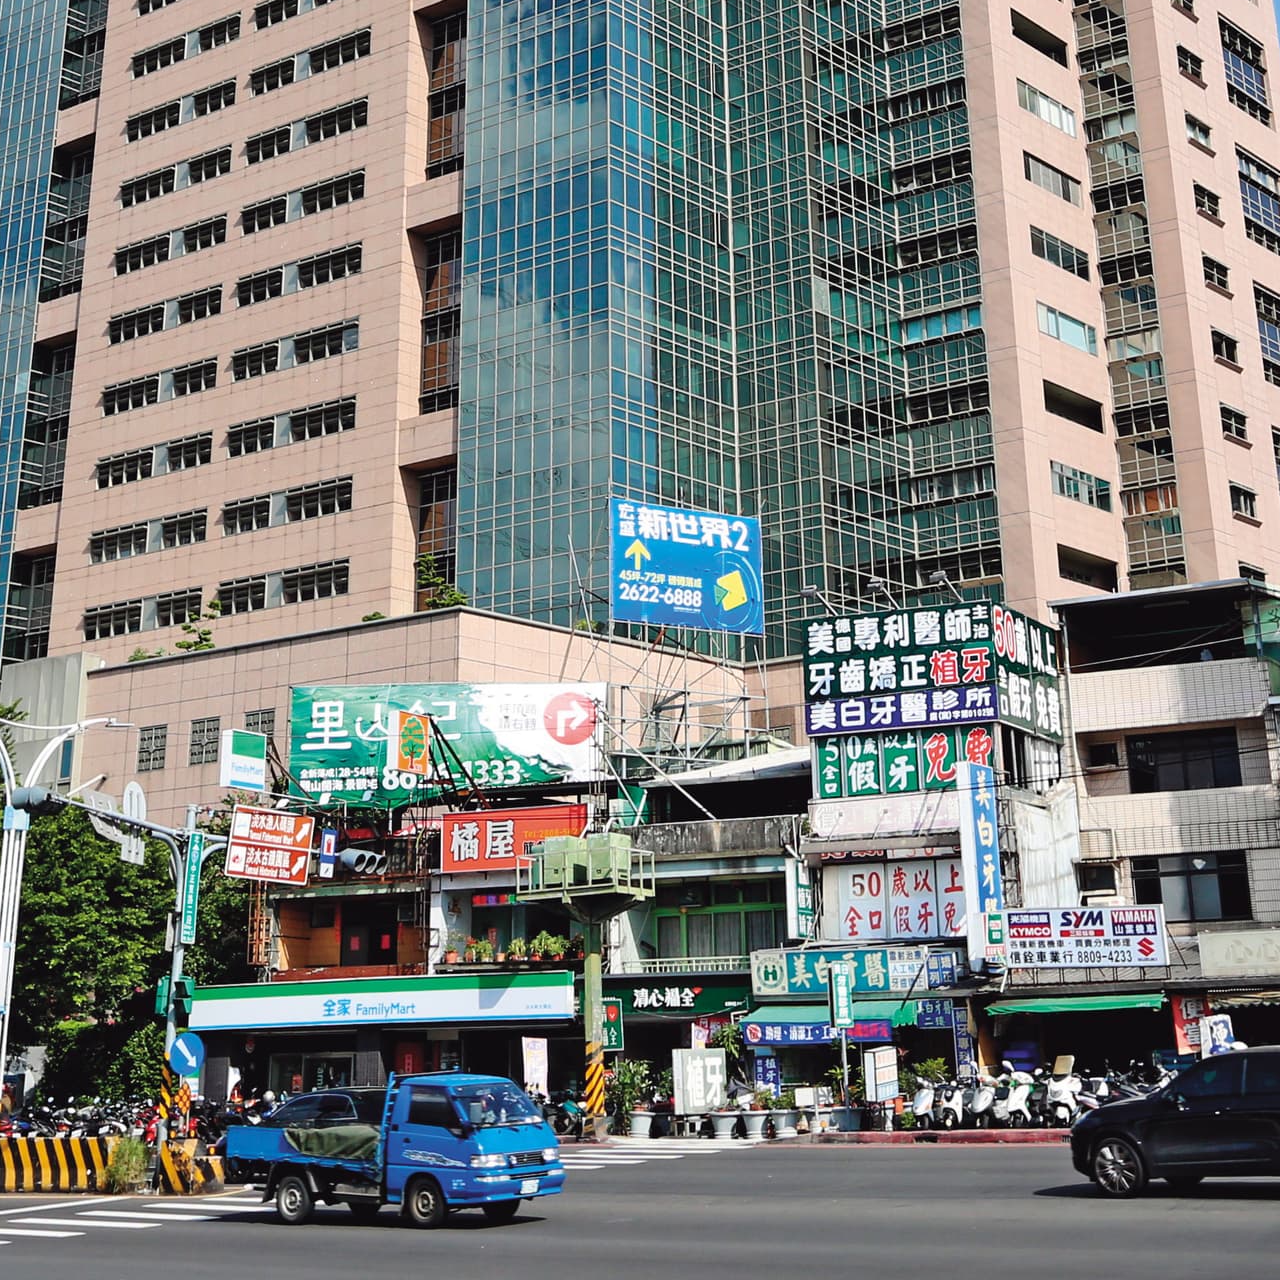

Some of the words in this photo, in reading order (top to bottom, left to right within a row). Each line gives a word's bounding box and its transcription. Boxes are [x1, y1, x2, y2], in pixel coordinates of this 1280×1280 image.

[637, 507, 749, 551] 新世界2
[619, 583, 702, 607] 2622-6888
[810, 687, 992, 730] 美白牙醫診所
[450, 820, 515, 861] 橘屋
[1060, 910, 1104, 928] SYM
[1112, 910, 1155, 923] YAMAHA
[1009, 927, 1051, 936] KYMCO
[1077, 950, 1133, 963] 8809-4233
[633, 986, 695, 1008] 清心福全
[323, 999, 352, 1017] 全家
[356, 1002, 416, 1019] FamilyMart
[687, 1056, 723, 1107] 植牙
